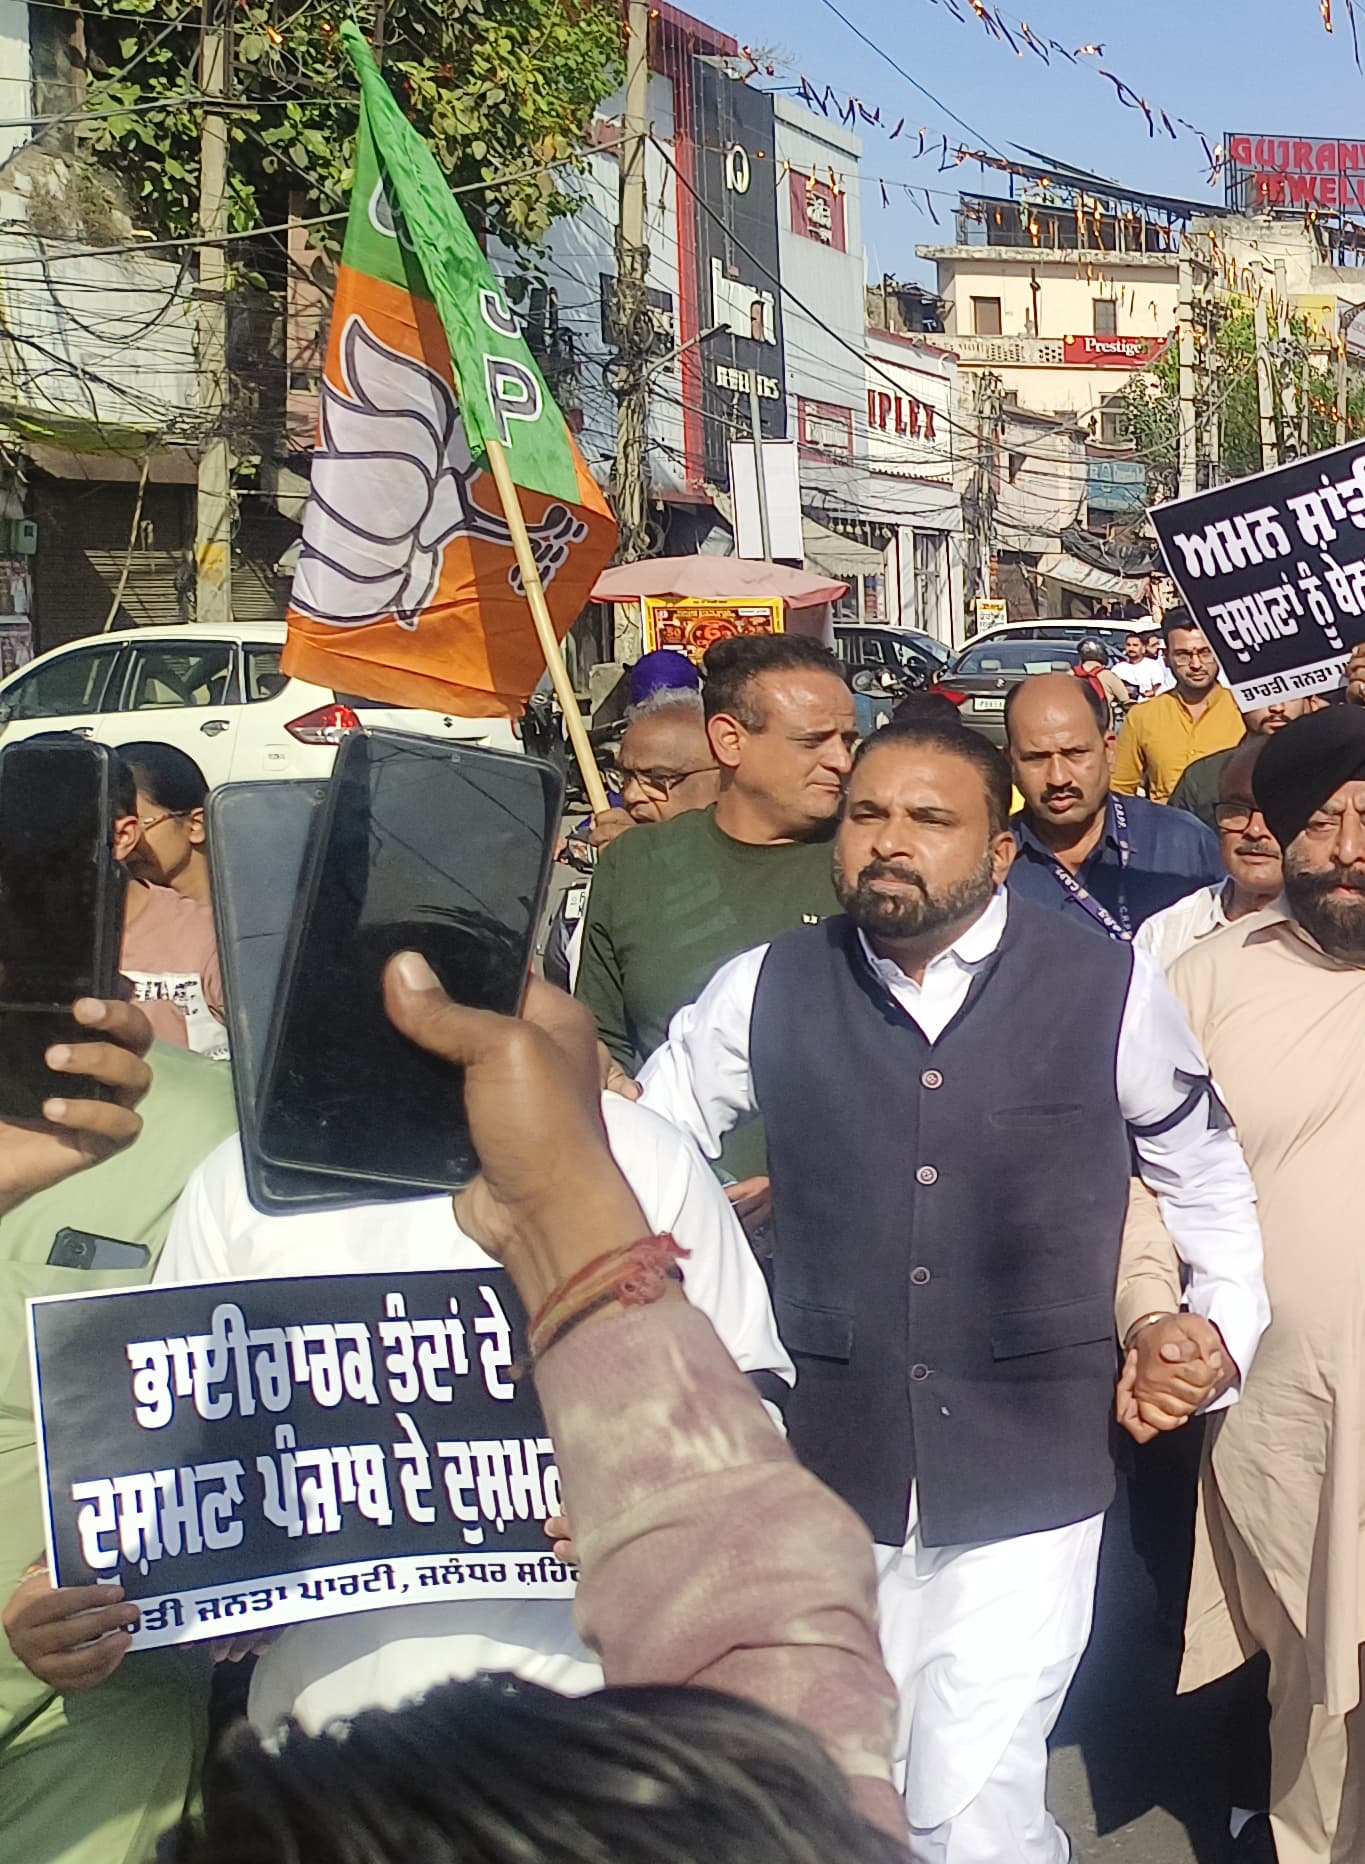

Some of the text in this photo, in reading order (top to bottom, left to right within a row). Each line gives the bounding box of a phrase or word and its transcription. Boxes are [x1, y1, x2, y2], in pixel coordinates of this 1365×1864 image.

[1084, 337, 1142, 357] Prestige
[1172, 506, 1292, 578] ਅਮਨ
[1206, 570, 1305, 663] ਦੁਸ਼ਮਣਾਂ
[1296, 561, 1345, 650] ਨੂੰ
[1240, 675, 1288, 702] ਭਾਰਤੀ
[1289, 668, 1334, 690] ਜਨਤਾ
[126, 1285, 516, 1431] ਭਾਈਚਾਰਕ ਤੰਦਾਂ ਦੇ
[71, 1458, 247, 1587] ਦੁਸ਼ਮਣ
[256, 1422, 394, 1538] ਪੰਜਾਬ
[393, 1413, 436, 1524] ਦੇ
[196, 1587, 289, 1622] ਜਨਤਾ
[298, 1563, 410, 1602] ਪਾਰਟੀ,
[415, 1557, 509, 1588] ਜਲੰਧਰ
